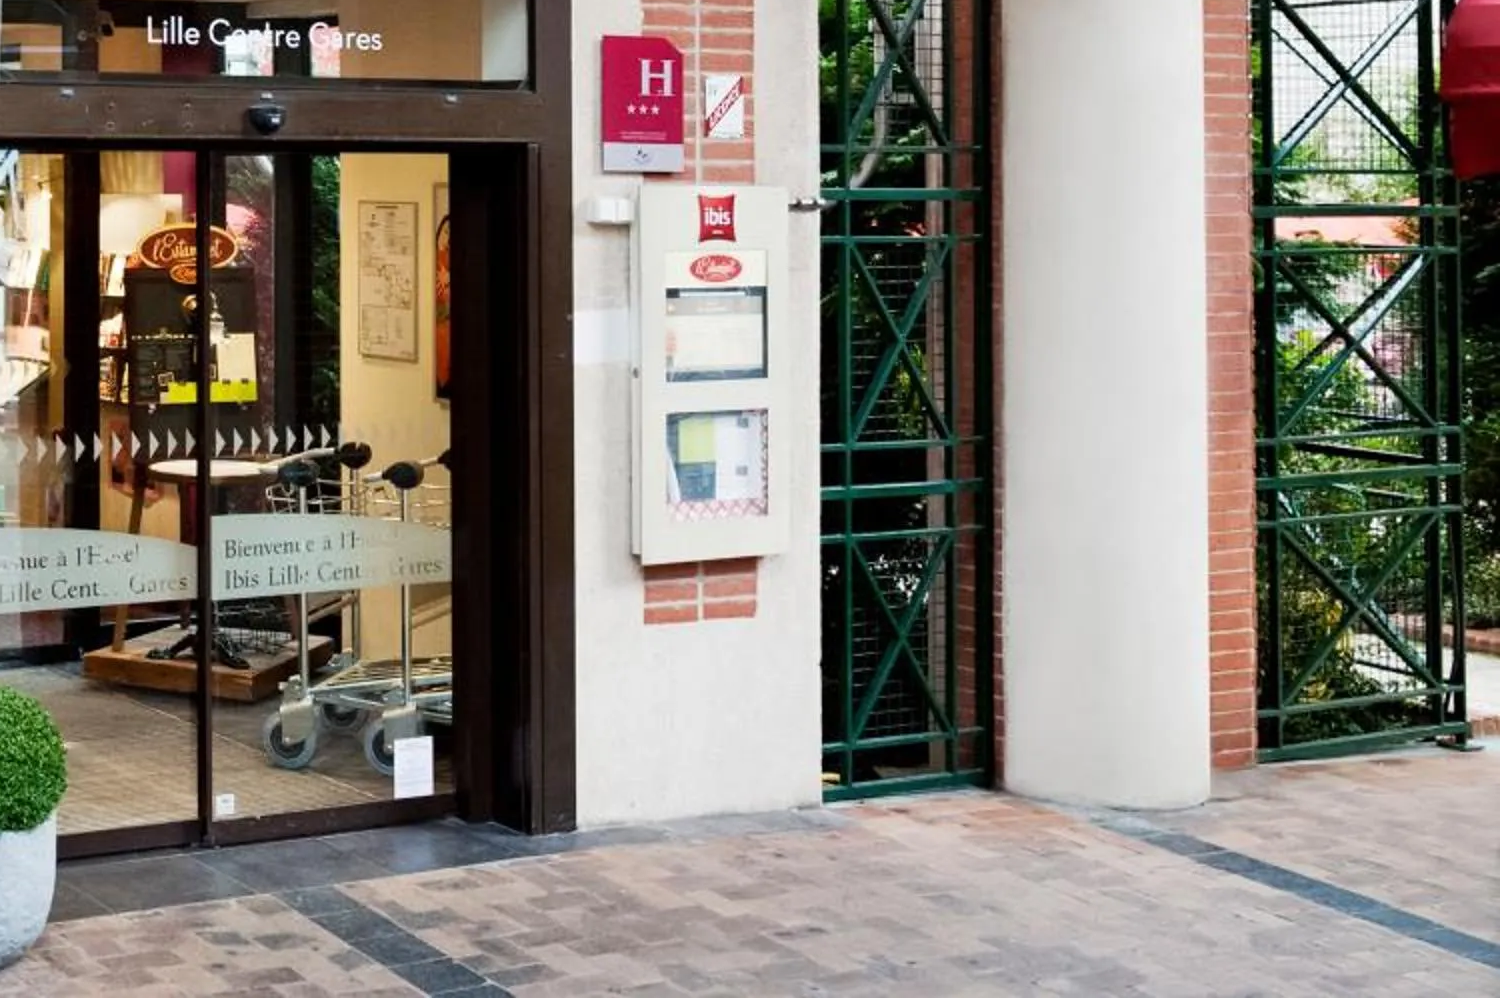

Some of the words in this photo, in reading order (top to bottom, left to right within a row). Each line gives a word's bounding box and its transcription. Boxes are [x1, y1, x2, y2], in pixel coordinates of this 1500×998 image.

[147, 16, 200, 45] Lille
[308, 21, 383, 51] Gares
[638, 58, 676, 97] H
[704, 207, 731, 226] ibis
[225, 568, 260, 590] Ibis
